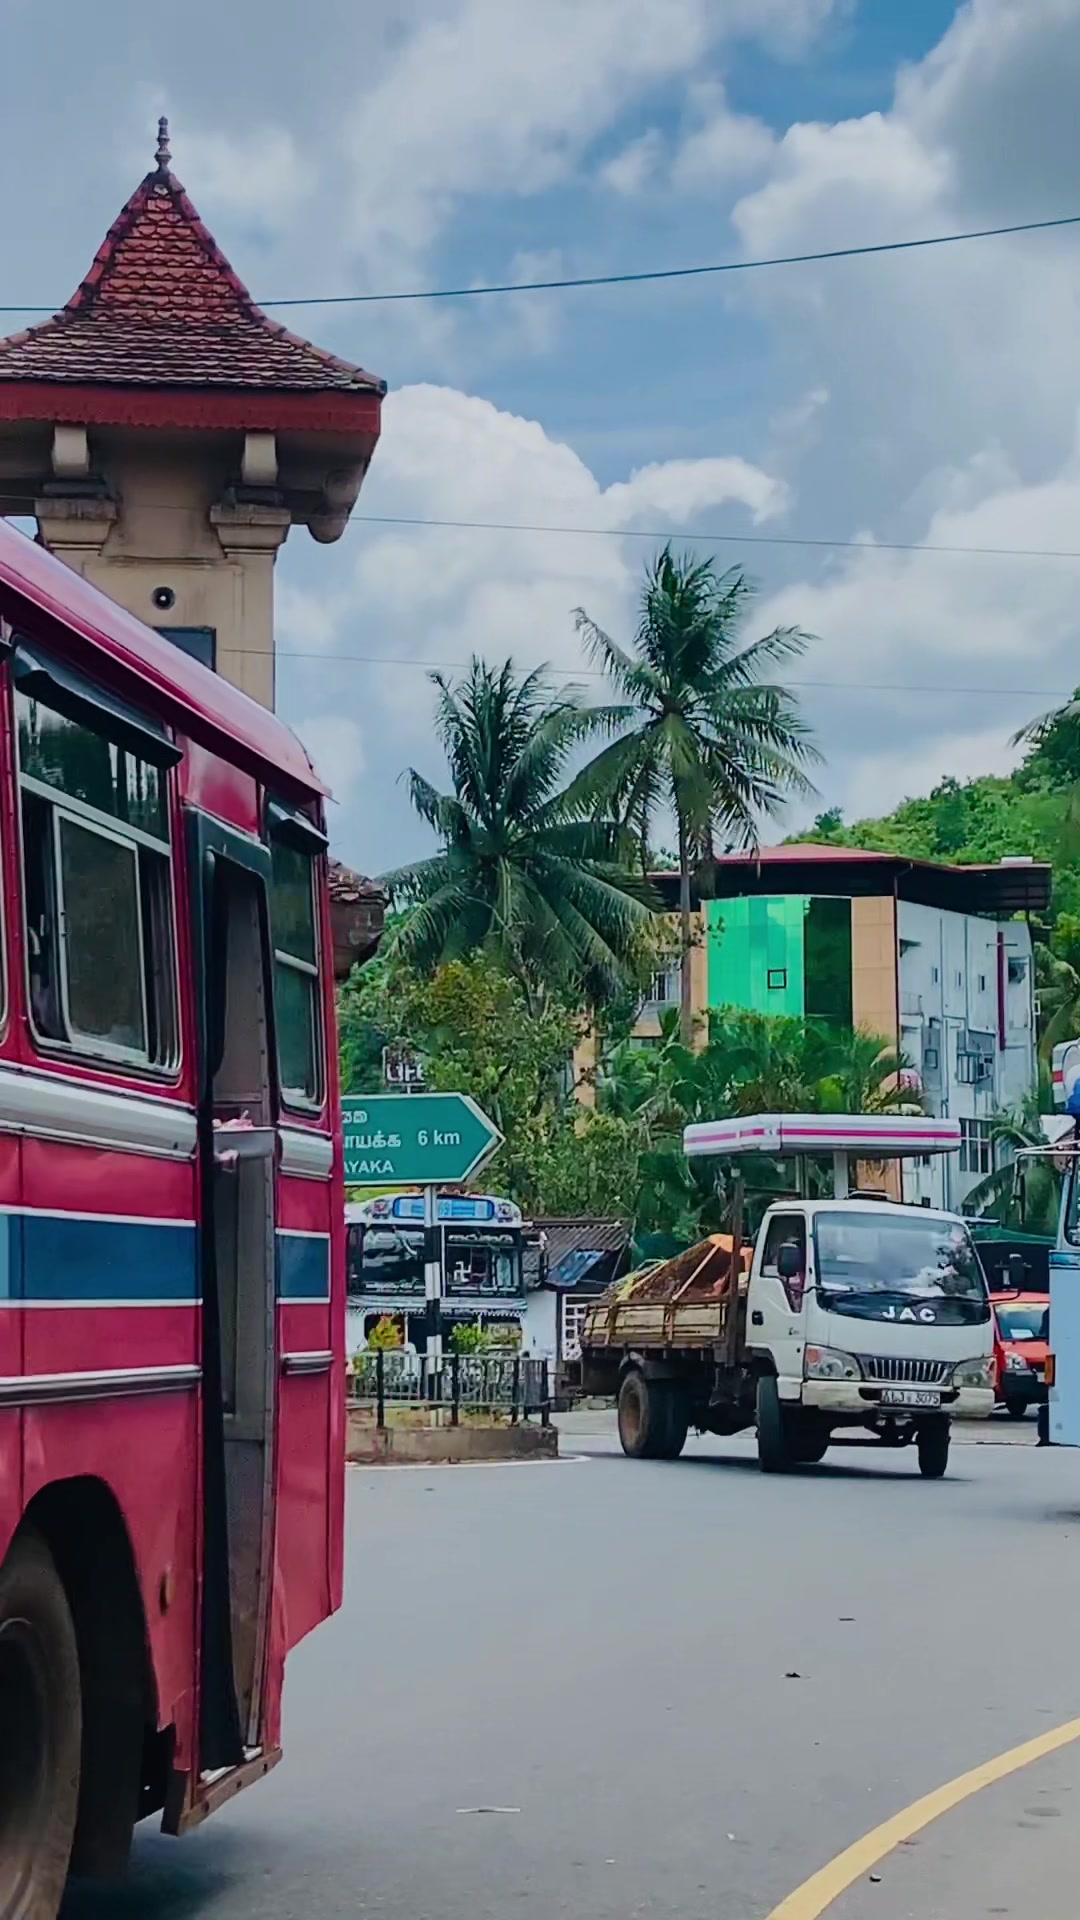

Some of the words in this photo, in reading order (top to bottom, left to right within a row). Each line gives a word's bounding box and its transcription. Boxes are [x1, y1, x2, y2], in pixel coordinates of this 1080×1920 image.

[417, 1130, 428, 1146] 6
[433, 1130, 460, 1145] km
[882, 1306, 936, 1322] JAC
